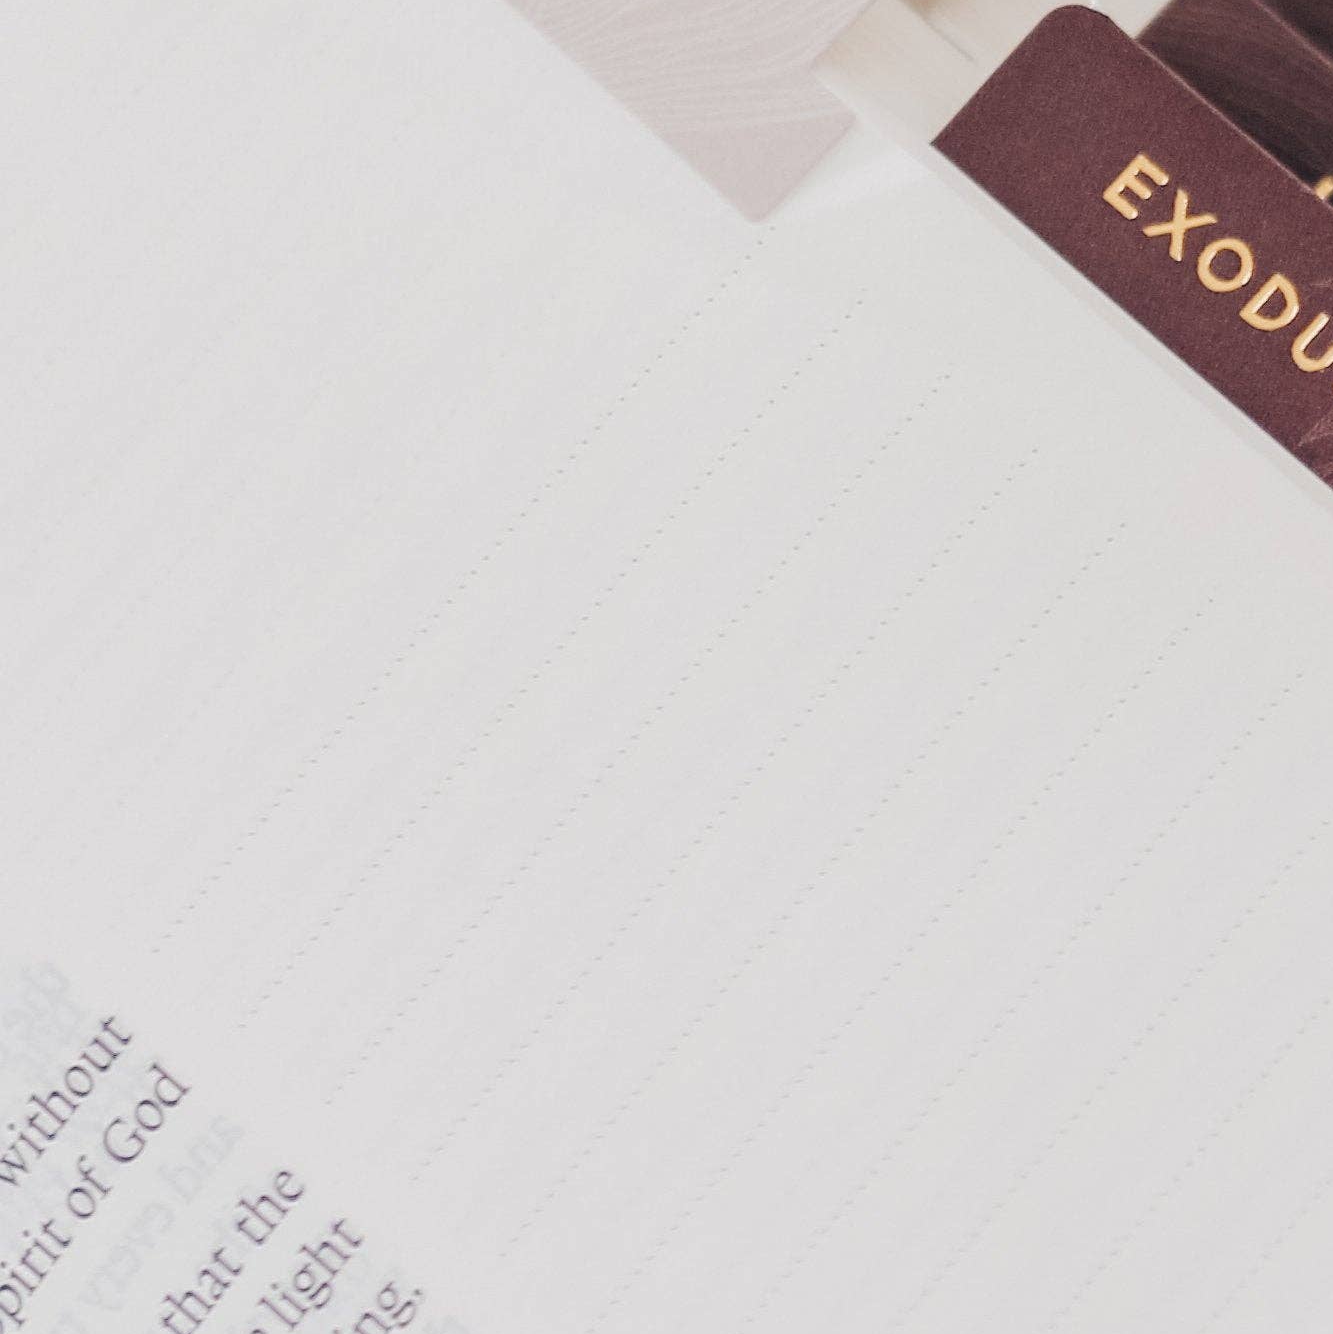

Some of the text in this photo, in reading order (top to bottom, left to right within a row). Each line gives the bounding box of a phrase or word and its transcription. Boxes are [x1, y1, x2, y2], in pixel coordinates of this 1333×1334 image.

[1, 1015, 133, 1188] without
[65, 1153, 113, 1221] of
[101, 1061, 191, 1165] God
[233, 1169, 306, 1247] the
[256, 1217, 365, 1332] light
